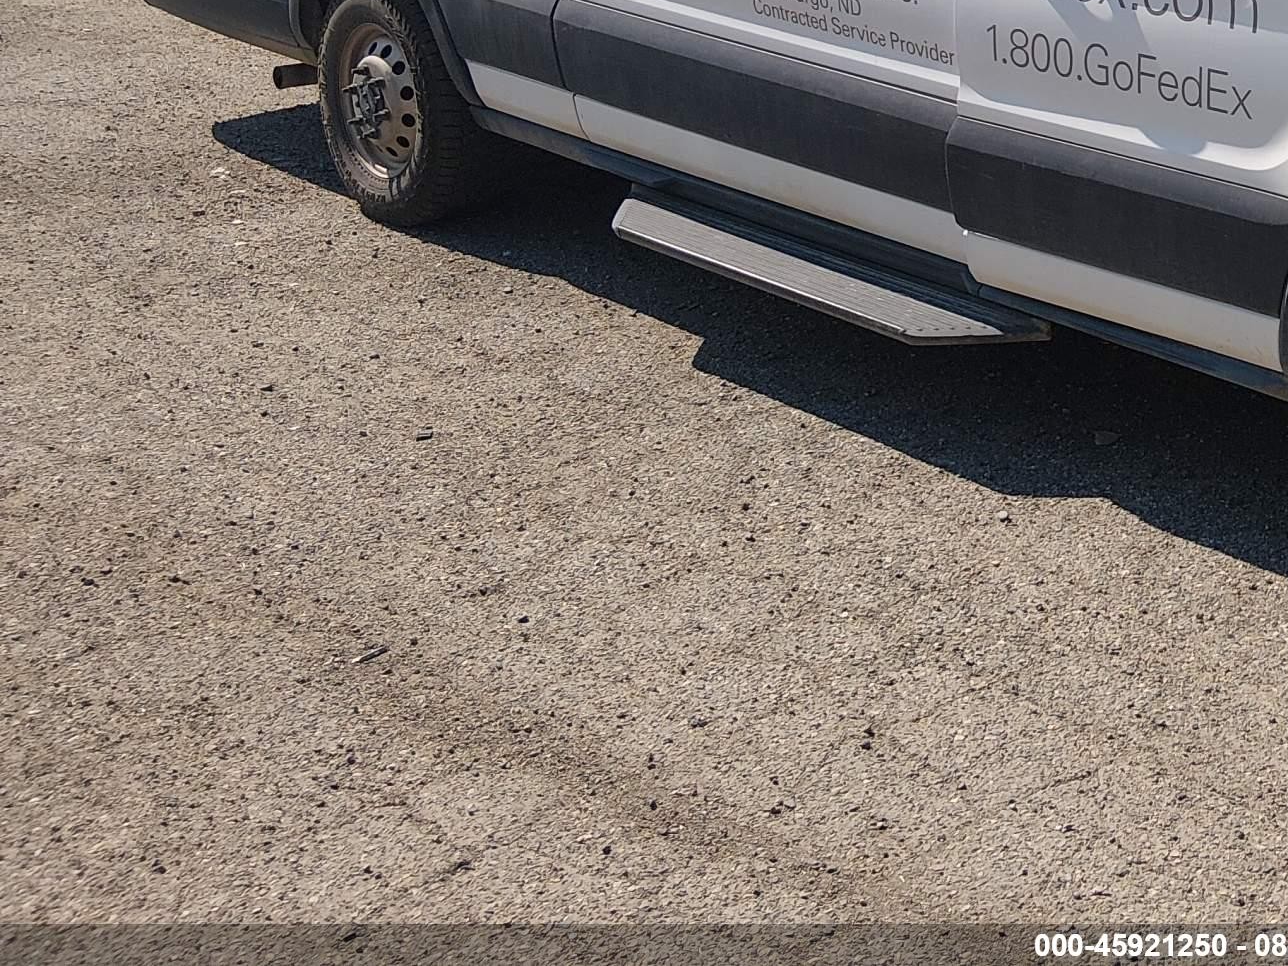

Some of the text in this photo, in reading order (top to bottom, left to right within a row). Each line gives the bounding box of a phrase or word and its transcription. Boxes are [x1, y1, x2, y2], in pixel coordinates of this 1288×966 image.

[831, 16, 887, 48] Service
[889, 31, 955, 67] Provider
[985, 23, 1254, 120] 1.800.GoFedEx
